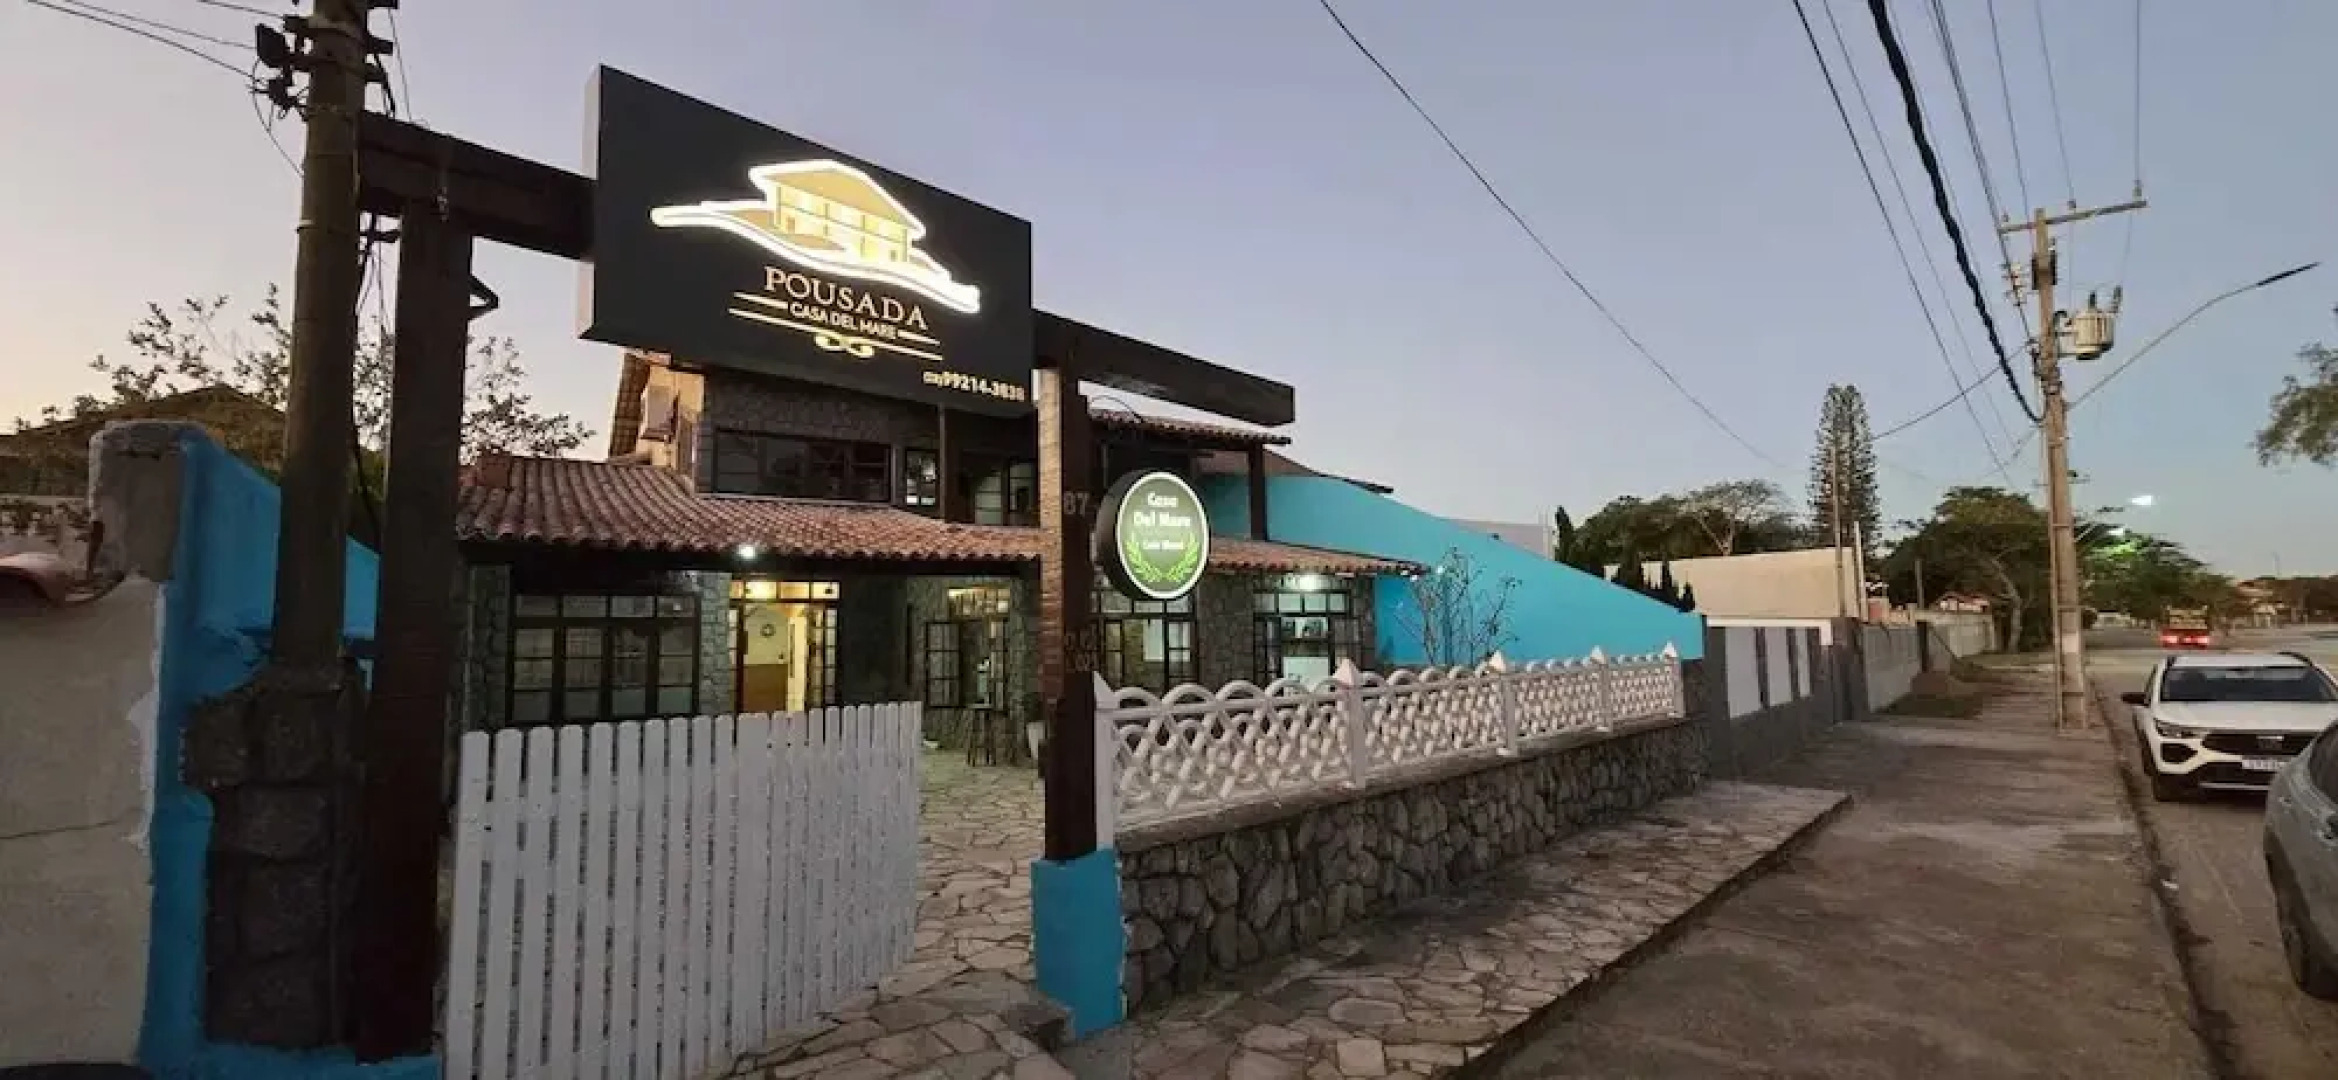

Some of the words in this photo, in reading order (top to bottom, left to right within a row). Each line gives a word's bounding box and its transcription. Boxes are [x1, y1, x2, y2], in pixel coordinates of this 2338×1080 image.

[763, 266, 929, 331] POUSADA
[789, 302, 828, 324] CASA
[830, 311, 859, 331] DEL
[859, 319, 897, 340] MARE
[1147, 491, 1178, 507] Casa
[1133, 511, 1156, 527] Del
[1159, 511, 1192, 527] Mare
